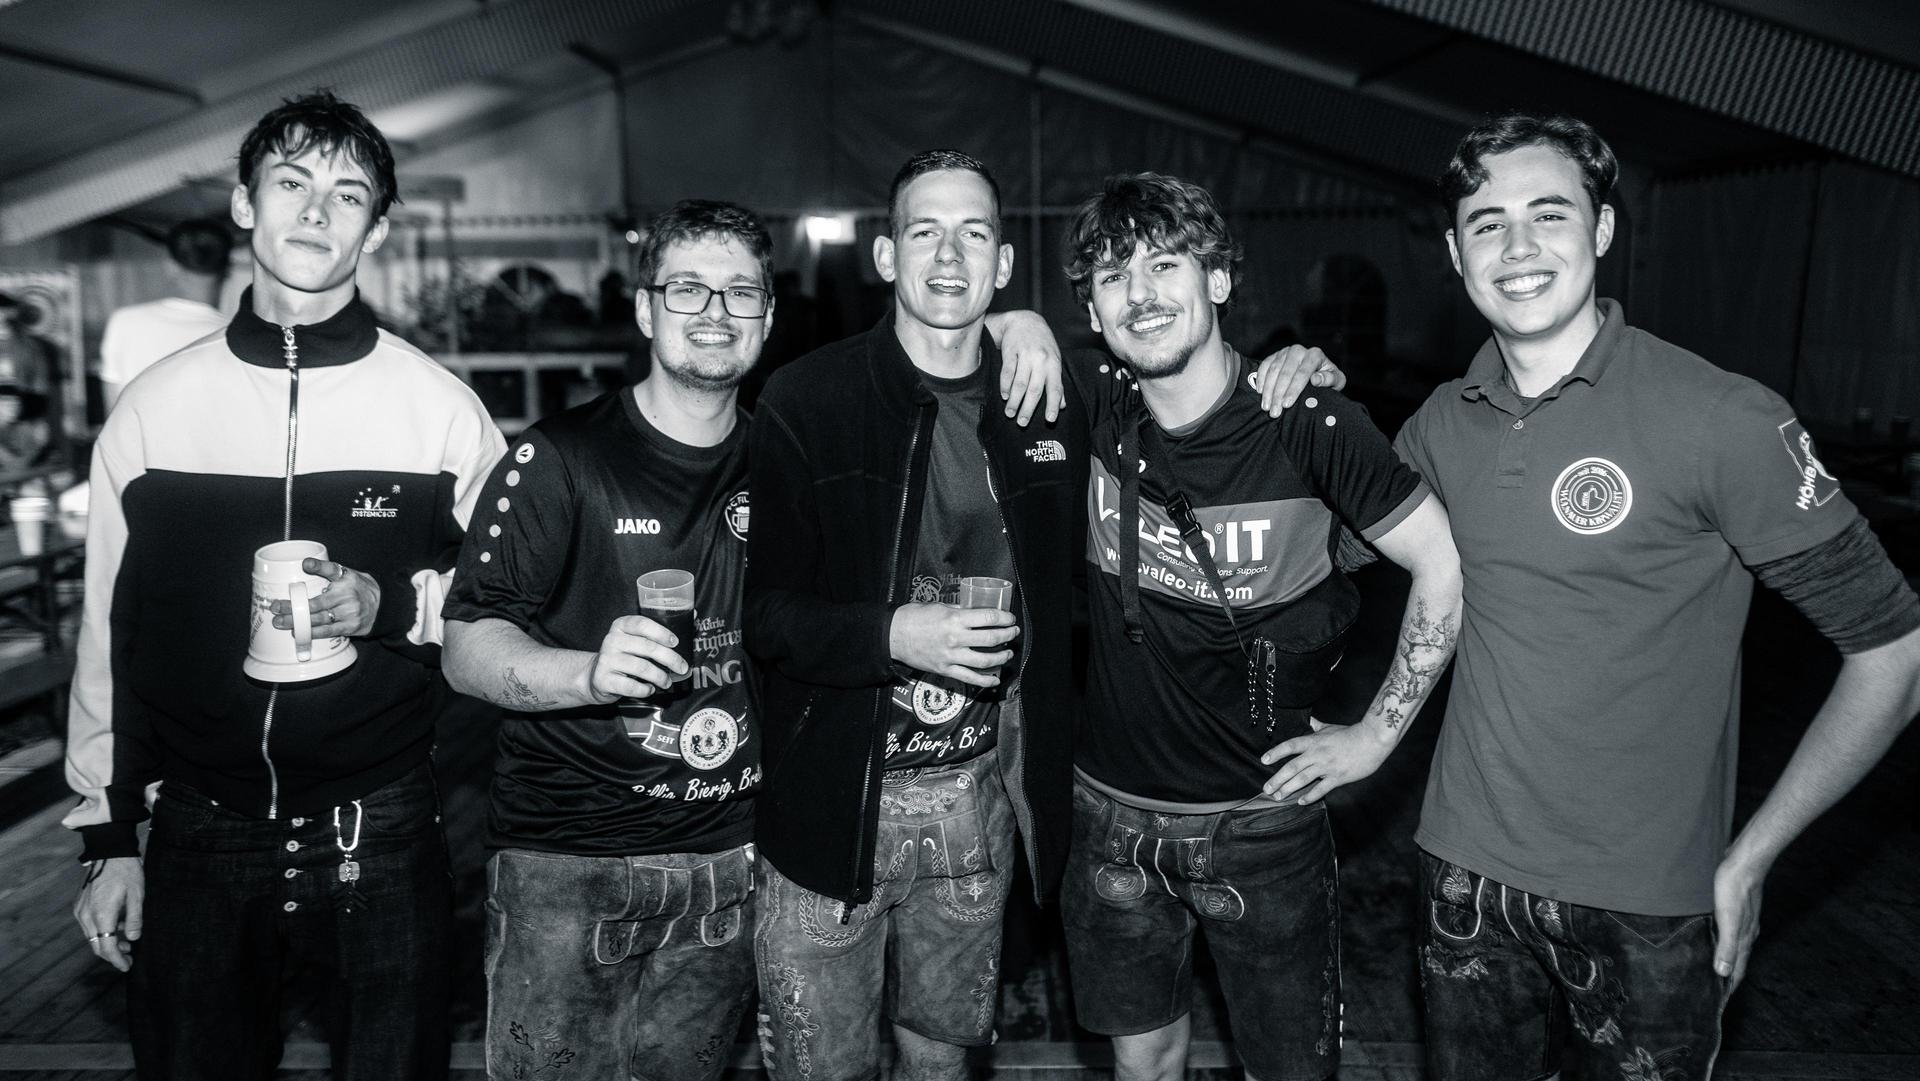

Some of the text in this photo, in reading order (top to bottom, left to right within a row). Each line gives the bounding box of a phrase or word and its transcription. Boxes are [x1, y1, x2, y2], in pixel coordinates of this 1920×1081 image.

[1036, 440, 1053, 448] THE
[1025, 447, 1054, 457] NORTH
[1033, 453, 1055, 463] FACE
[614, 518, 661, 535] JAKO
[1226, 519, 1271, 563] IT
[656, 734, 676, 746] SEIT
[683, 778, 736, 802] Bierig.
